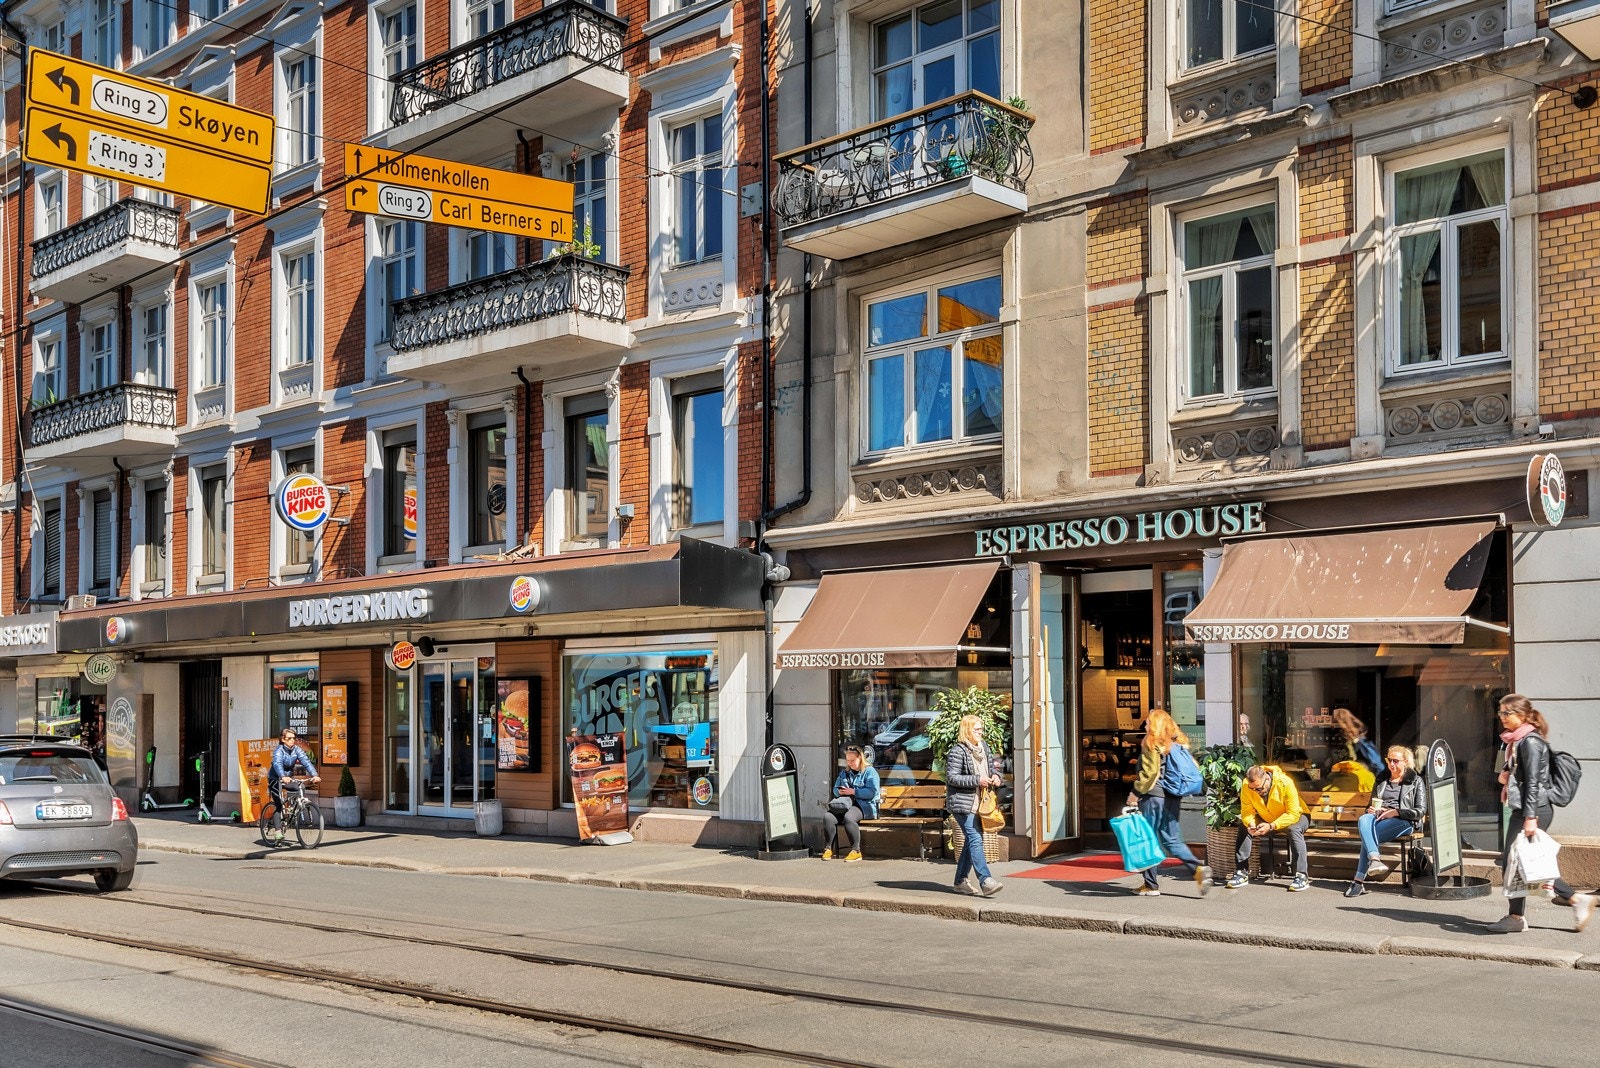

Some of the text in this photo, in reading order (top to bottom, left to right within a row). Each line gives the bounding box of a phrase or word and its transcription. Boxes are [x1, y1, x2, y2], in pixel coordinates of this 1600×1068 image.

[104, 88, 259, 146] Ring 2 Skøyen
[101, 143, 153, 168] Ring 3
[377, 154, 489, 191] Holmenkollen
[385, 191, 567, 237] Ring 2 Carl Berners pl.
[286, 486, 324, 502] BURGER
[287, 496, 326, 516] KING
[975, 502, 1266, 557] ESPRESSO HOUSE
[513, 582, 530, 595] BURGER
[513, 588, 530, 603] KING
[289, 588, 428, 628] BURGER KING
[1193, 624, 1350, 641] ESPRESSO HOUSE
[393, 645, 414, 657] BURGER
[393, 651, 415, 665] KING
[782, 652, 886, 667] ESPRESSO HOUSE
[279, 690, 317, 701] WHOPPER
[289, 706, 308, 719] 100%
[297, 726, 308, 735] BEEF
[45, 806, 90, 816] EK 58892
